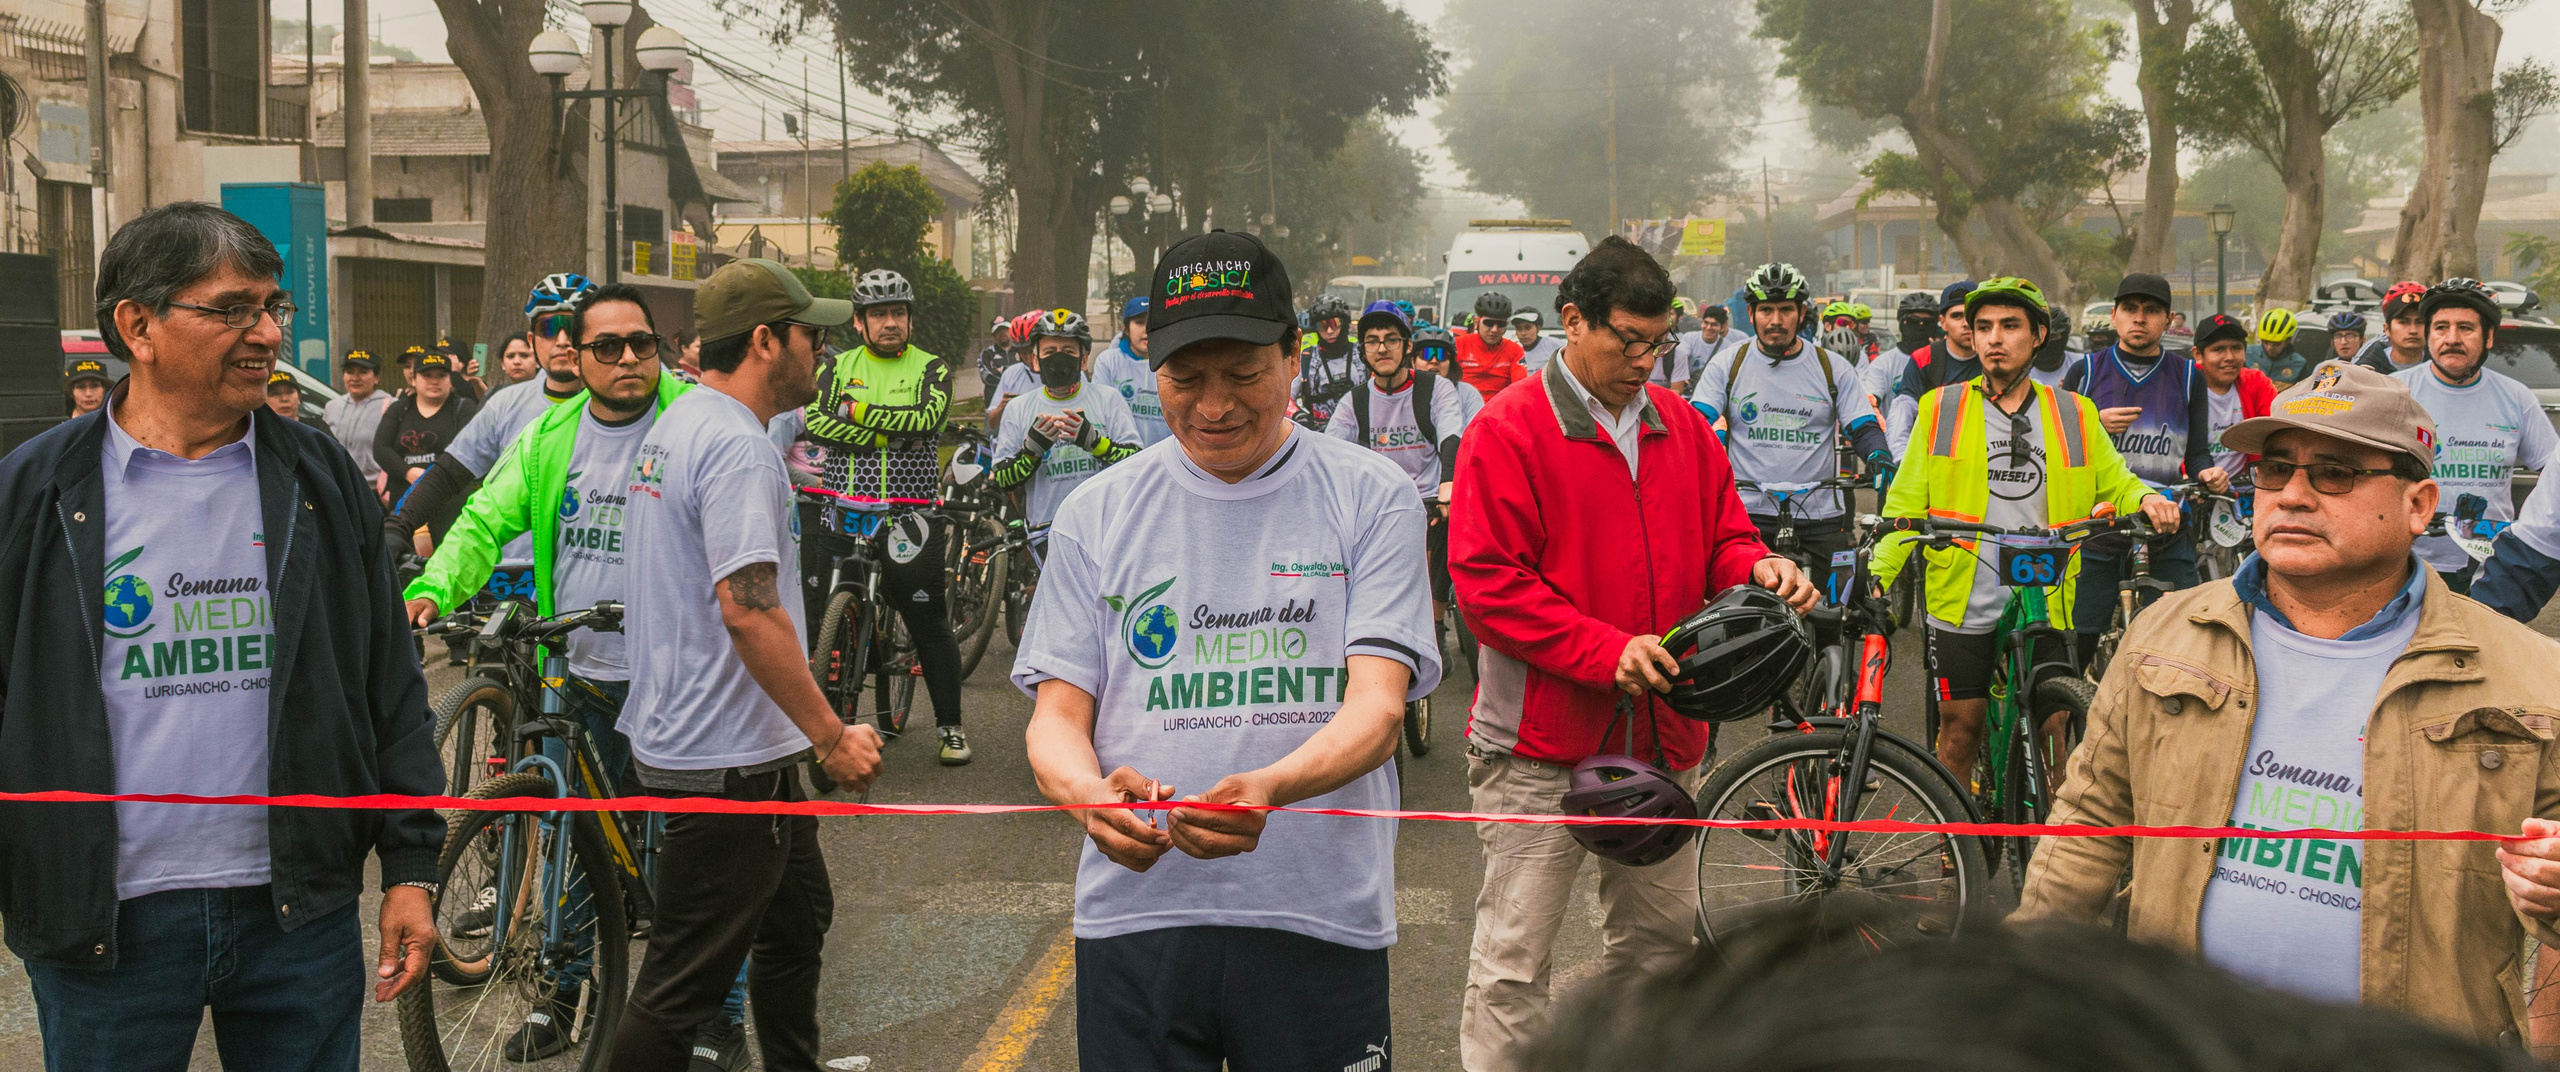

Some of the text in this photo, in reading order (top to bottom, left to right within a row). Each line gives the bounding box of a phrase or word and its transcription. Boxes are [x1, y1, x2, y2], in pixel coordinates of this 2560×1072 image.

[1169, 260, 1251, 279] LURIGANCHO
[1478, 273, 1562, 285] WAWITA
[307, 236, 316, 326] movistar
[1761, 403, 1813, 417] Semana del
[1764, 413, 1807, 429] MEDIO
[1748, 427, 1821, 445] AMBIENTE
[2447, 436, 2505, 449] Semana del
[2450, 448, 2505, 462] MEDIO
[1988, 469, 2037, 483] ONESELF
[843, 511, 878, 535] 50
[1271, 562, 1288, 573] Ing.
[1291, 562, 1327, 572] Oswaldo
[2011, 553, 2056, 584] 63
[165, 572, 262, 598] Semana
[489, 570, 537, 600] 64
[173, 596, 276, 633] MEDI
[1189, 599, 1317, 630] Semana del
[1195, 628, 1307, 666] MEDIO
[145, 680, 231, 699] LURIGANCHO
[1163, 715, 1242, 731] LURIGANCHO
[1252, 712, 1306, 726] CHOSICA
[1308, 711, 1336, 724] 2023
[2249, 750, 2354, 793] Semana
[1344, 1054, 1381, 1072] PUMA
